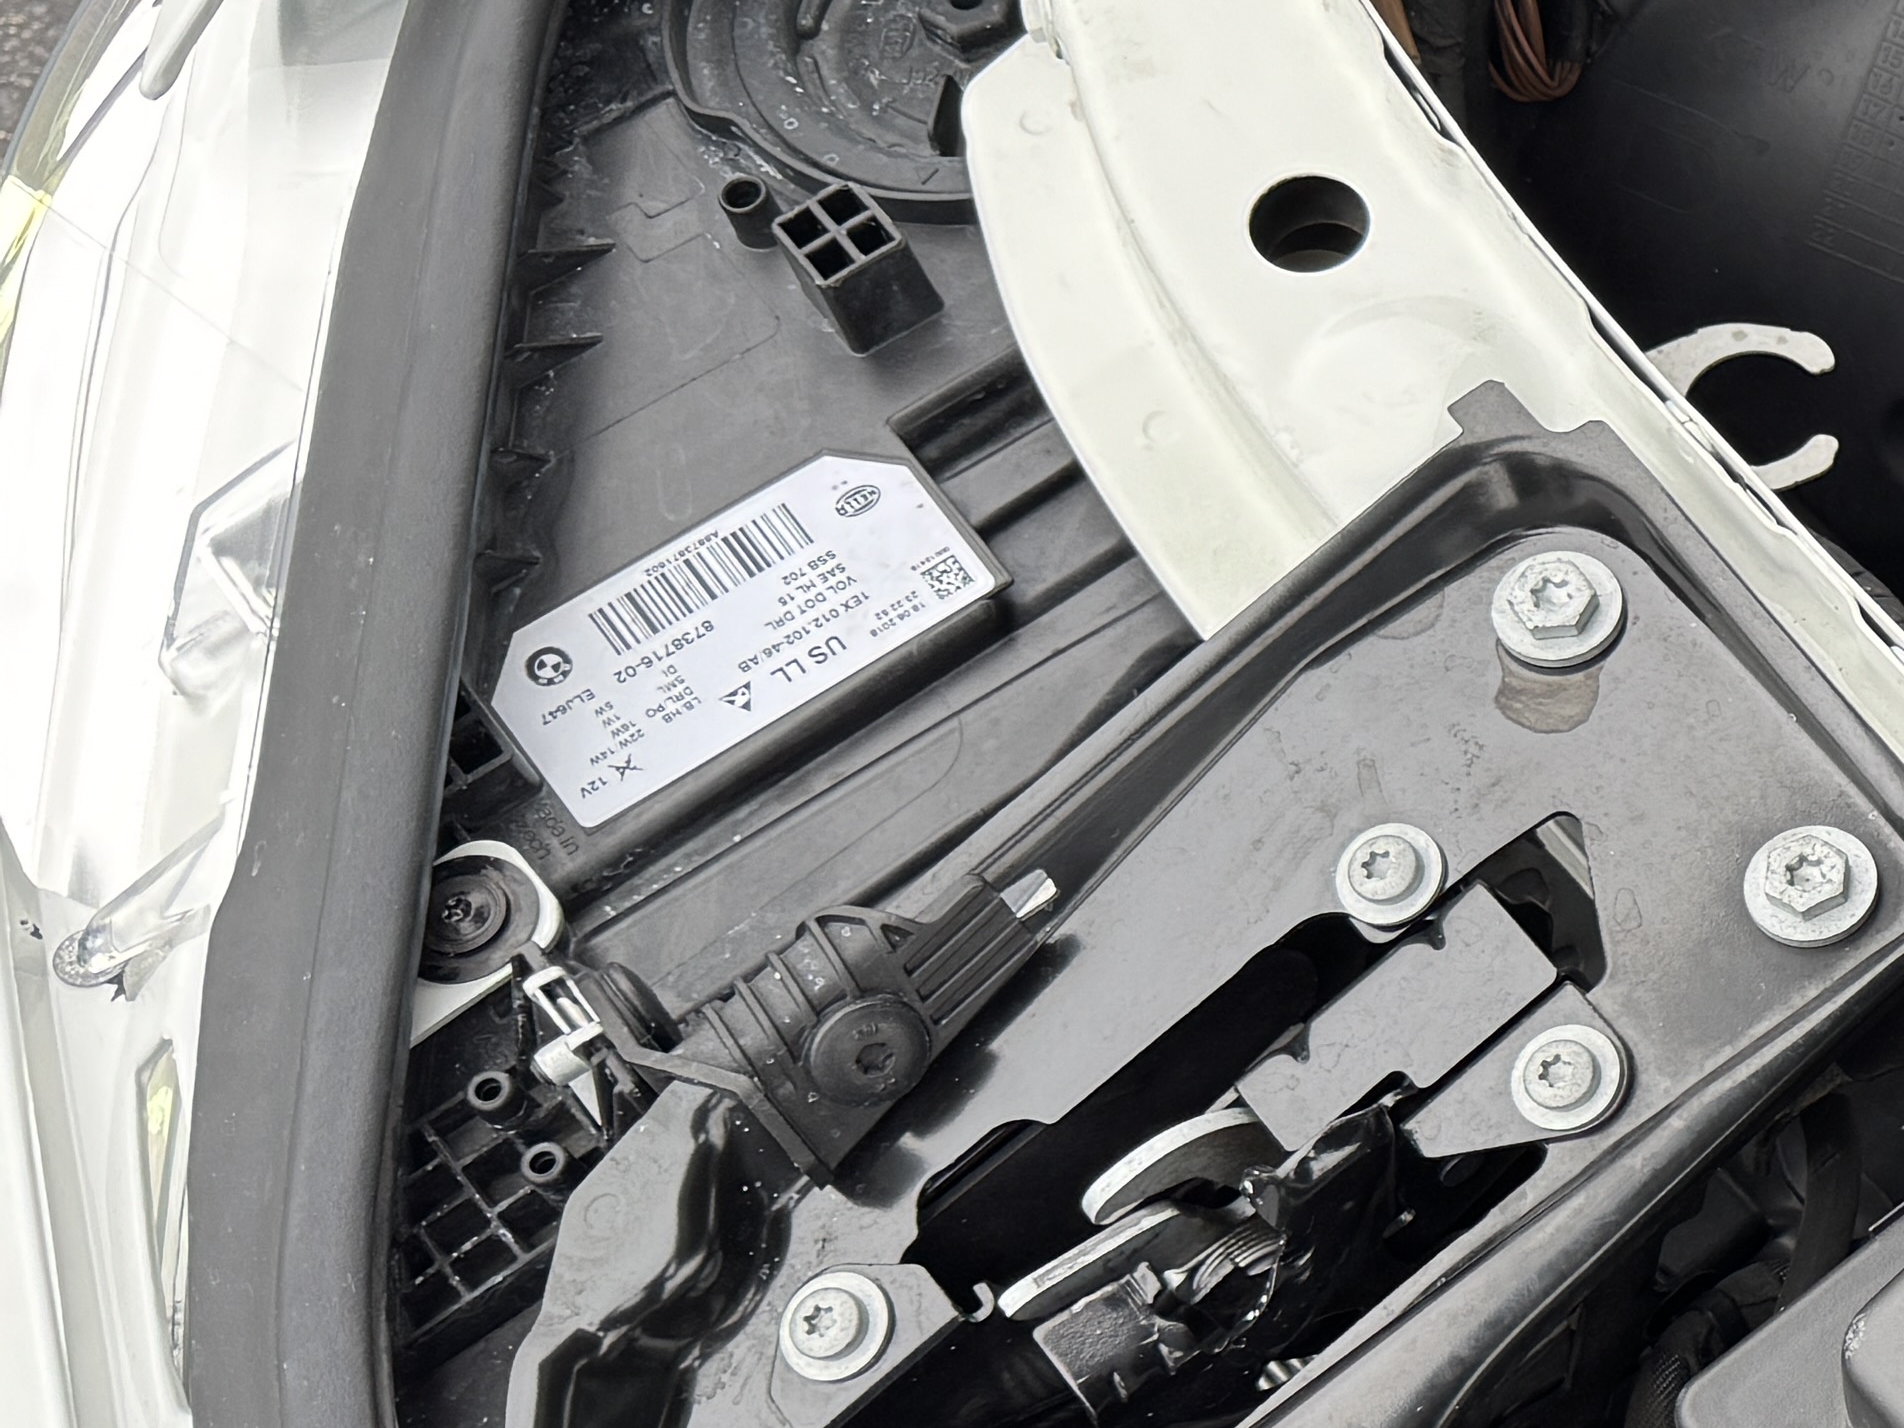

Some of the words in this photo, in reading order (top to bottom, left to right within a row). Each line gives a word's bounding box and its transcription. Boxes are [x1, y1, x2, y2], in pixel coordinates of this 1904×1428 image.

[832, 485, 879, 519] HELLA
[805, 547, 838, 571] SSB
[778, 565, 807, 587] 702
[815, 560, 847, 584] SAE
[824, 572, 858, 597] VOL
[794, 590, 828, 615] DOT
[838, 589, 870, 613] 1EX
[763, 608, 796, 633] DRL
[611, 617, 717, 685] 8738716-02
[804, 633, 848, 666] US
[768, 657, 807, 688] LL
[537, 687, 596, 726] ELJ647
[590, 699, 615, 718] 5W
[599, 711, 621, 728] 1W
[575, 774, 609, 799] 12V
